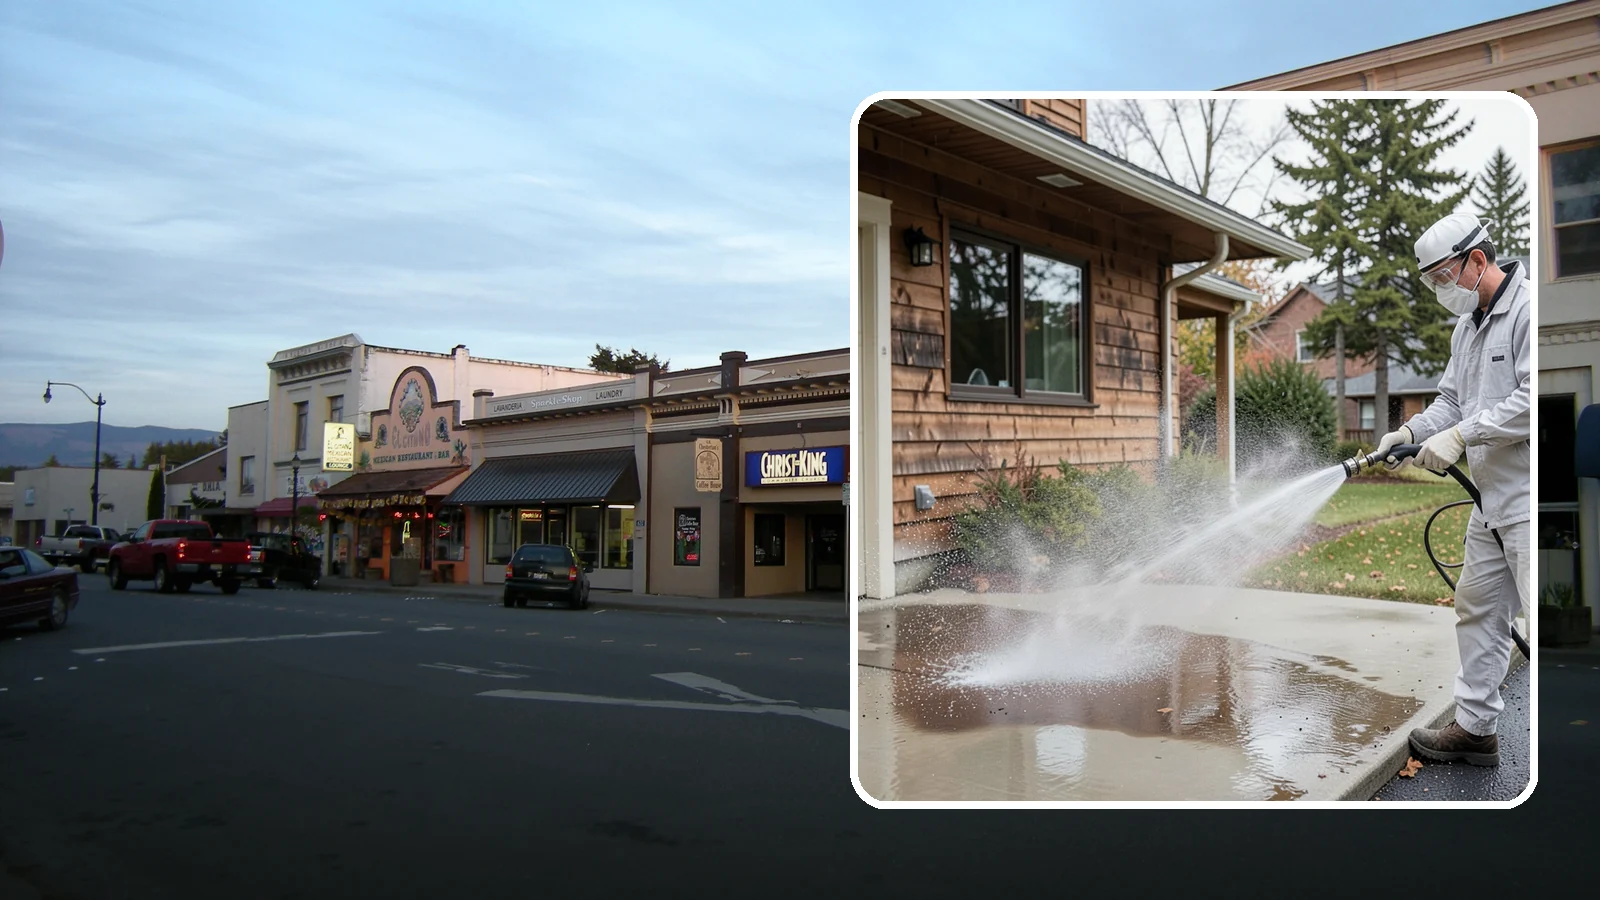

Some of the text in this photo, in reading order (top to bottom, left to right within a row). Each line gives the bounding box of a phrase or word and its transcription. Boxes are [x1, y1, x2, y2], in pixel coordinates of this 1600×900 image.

[531, 394, 582, 409] Sparkle Shop
[596, 389, 623, 400] LAUNDRY
[493, 402, 522, 412] LAVANDERIA
[373, 455, 396, 464] MEXICAN
[397, 451, 433, 462] RESTAURANT
[437, 450, 450, 459] BAR
[761, 450, 827, 478] CHRIST KING
